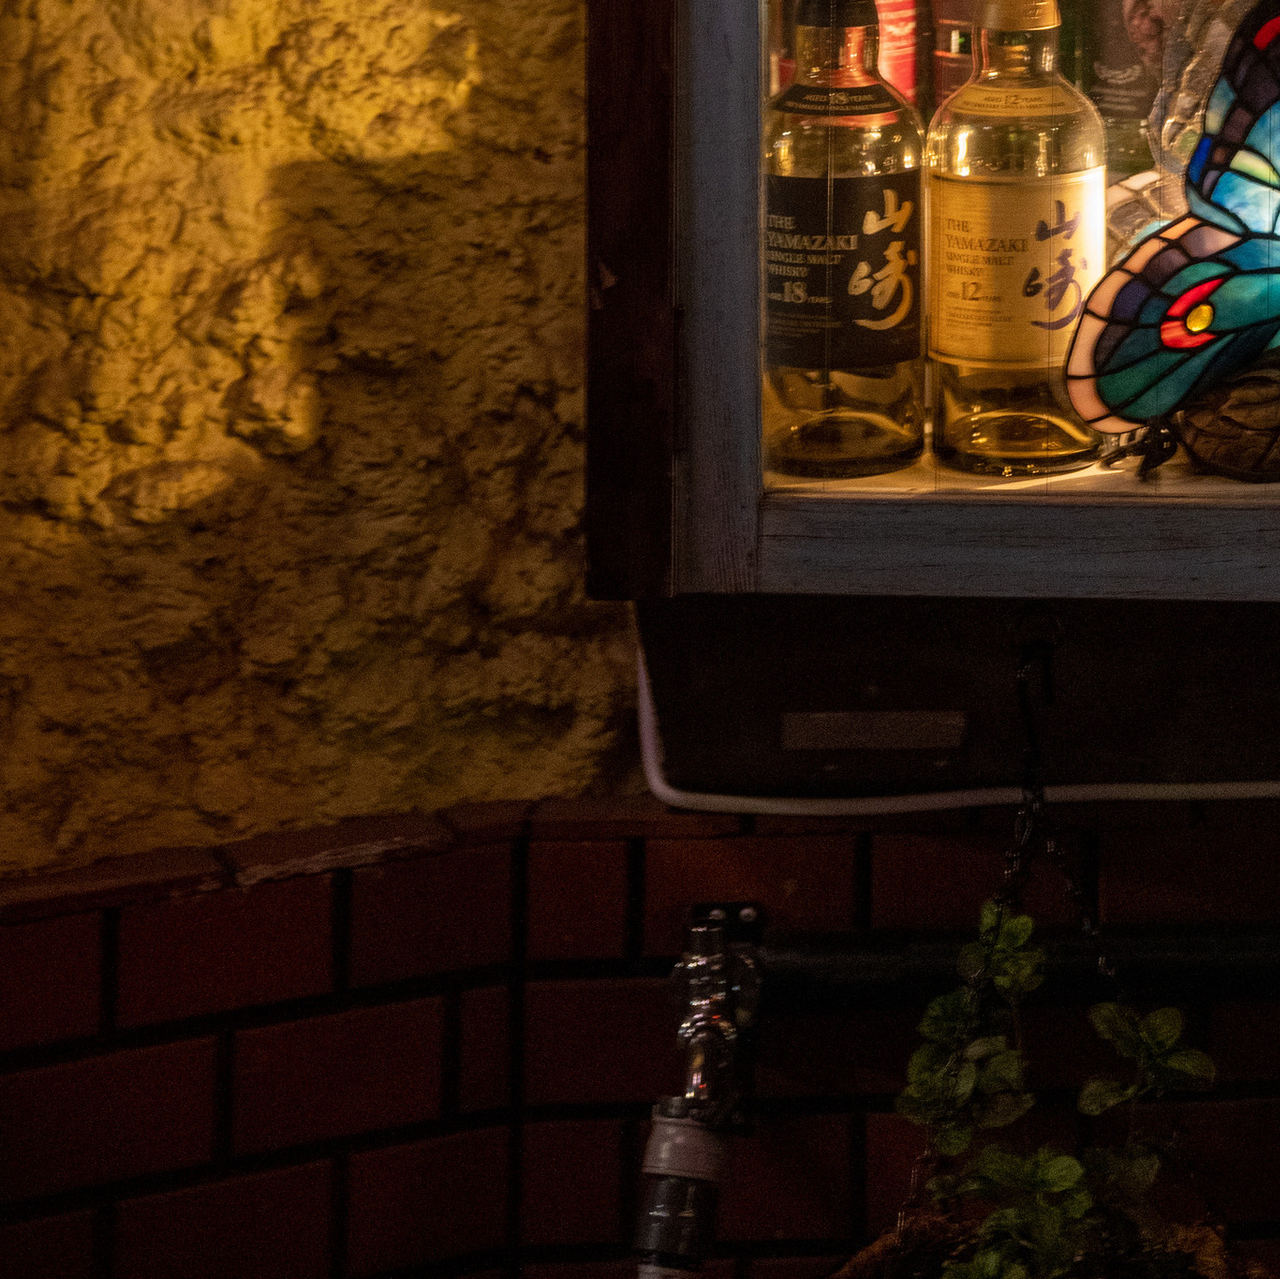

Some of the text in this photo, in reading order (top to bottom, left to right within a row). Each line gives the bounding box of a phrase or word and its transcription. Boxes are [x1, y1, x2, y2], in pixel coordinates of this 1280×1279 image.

[829, 92, 849, 105] 18
[1004, 94, 1021, 105] 12
[767, 215, 796, 230] THE
[945, 218, 970, 233] THE
[766, 231, 859, 251] YAMAZAKI
[944, 233, 1029, 253] YAMAZAKI
[766, 250, 844, 265] SINGLE MALT
[946, 251, 1015, 267] SINGLE MALT
[767, 264, 808, 278] WHISKY
[946, 264, 982, 278] WHISKY
[783, 280, 808, 303] 18
[961, 280, 982, 301] 12
